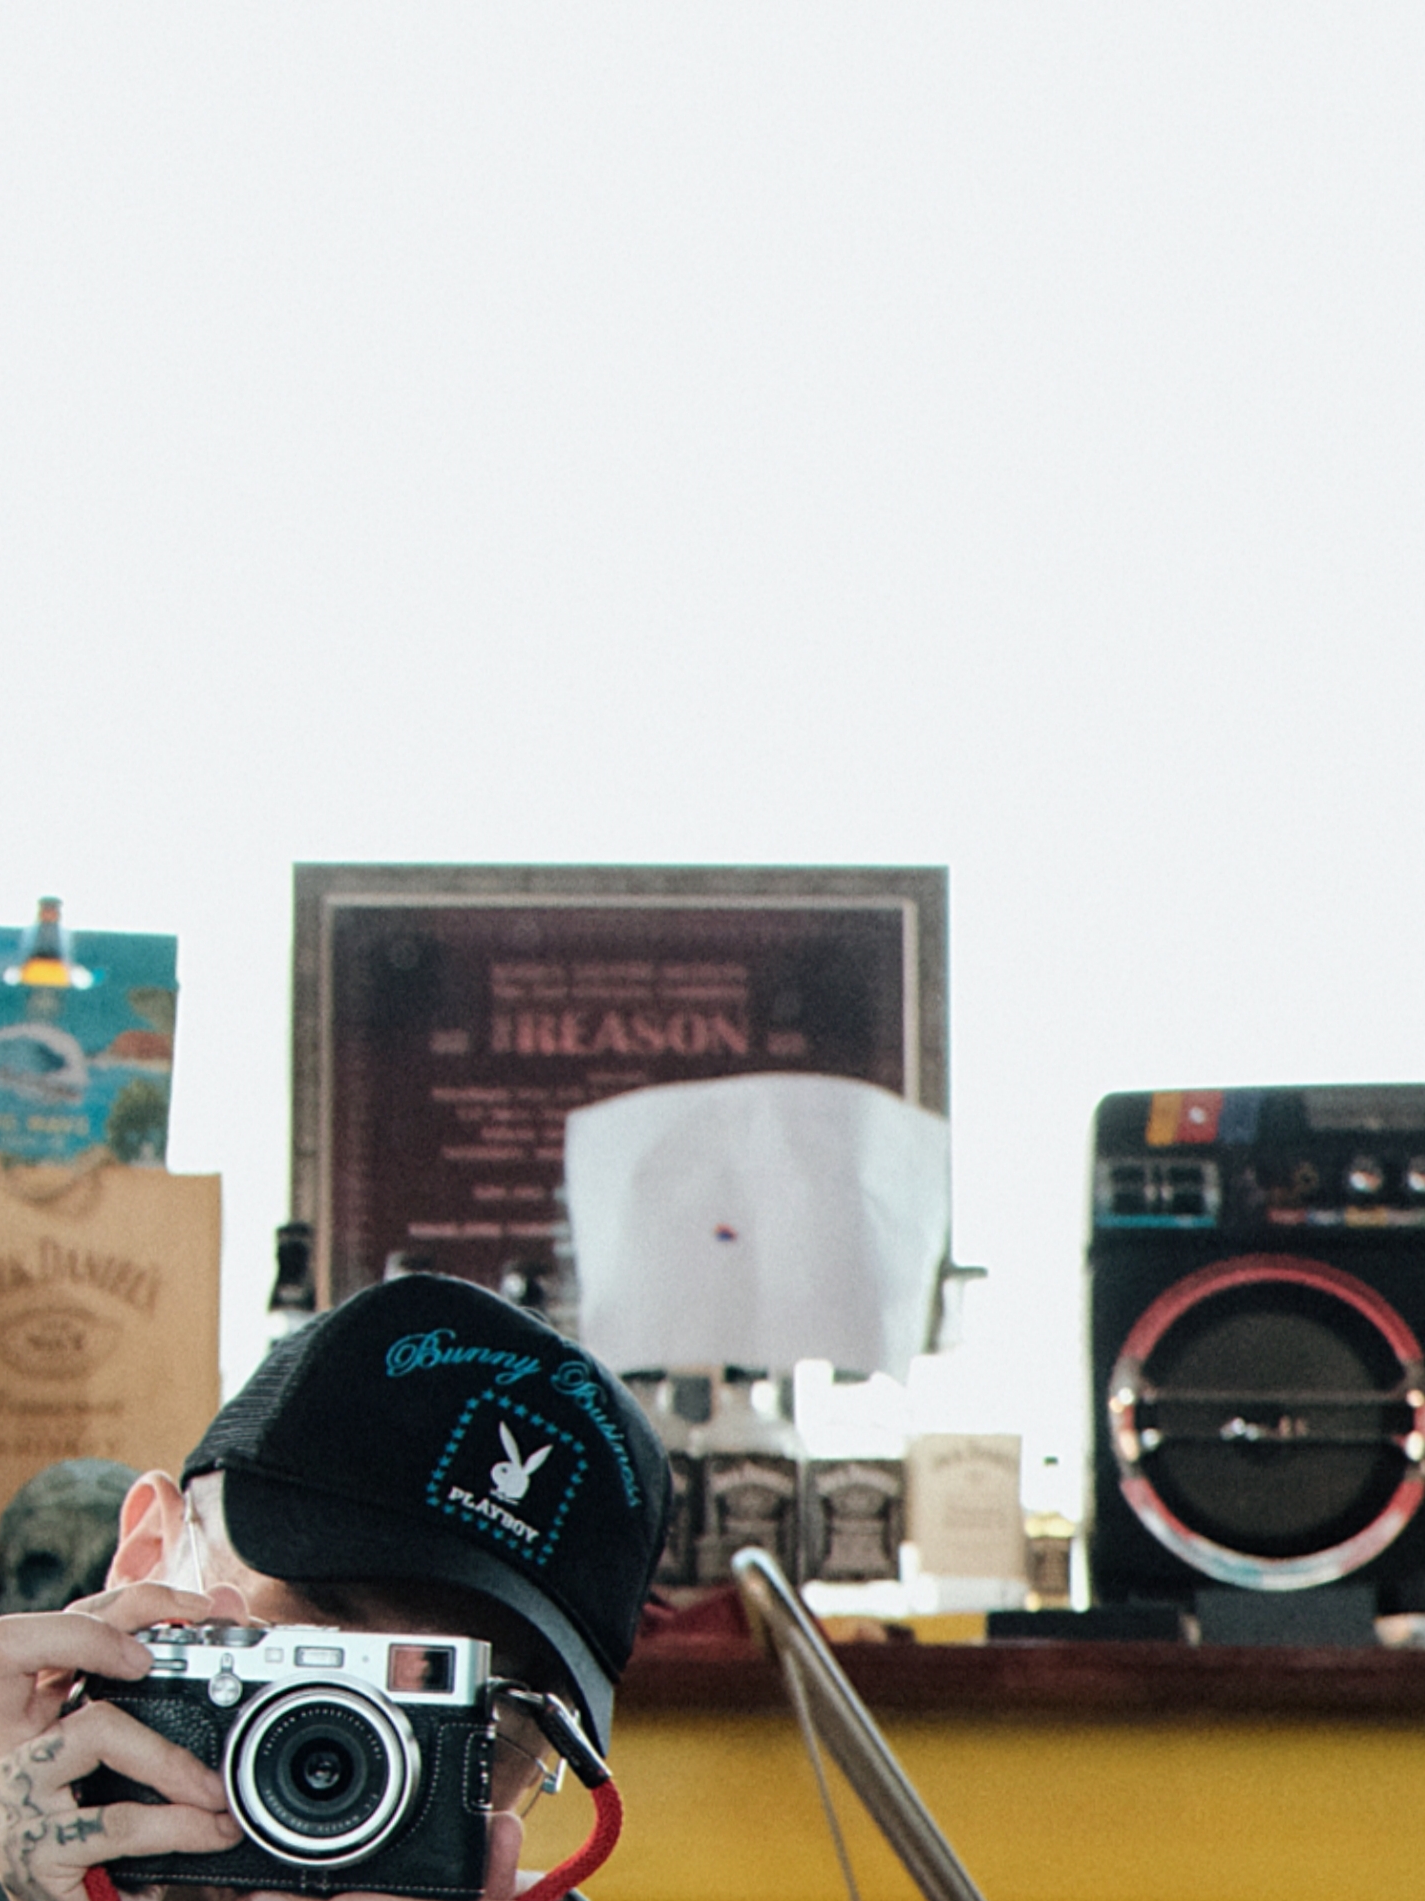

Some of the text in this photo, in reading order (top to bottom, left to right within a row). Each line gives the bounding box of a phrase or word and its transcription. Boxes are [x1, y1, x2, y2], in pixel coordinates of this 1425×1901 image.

[385, 1328, 642, 1507] Bunny Business
[447, 1485, 540, 1543] PLAYBOY
